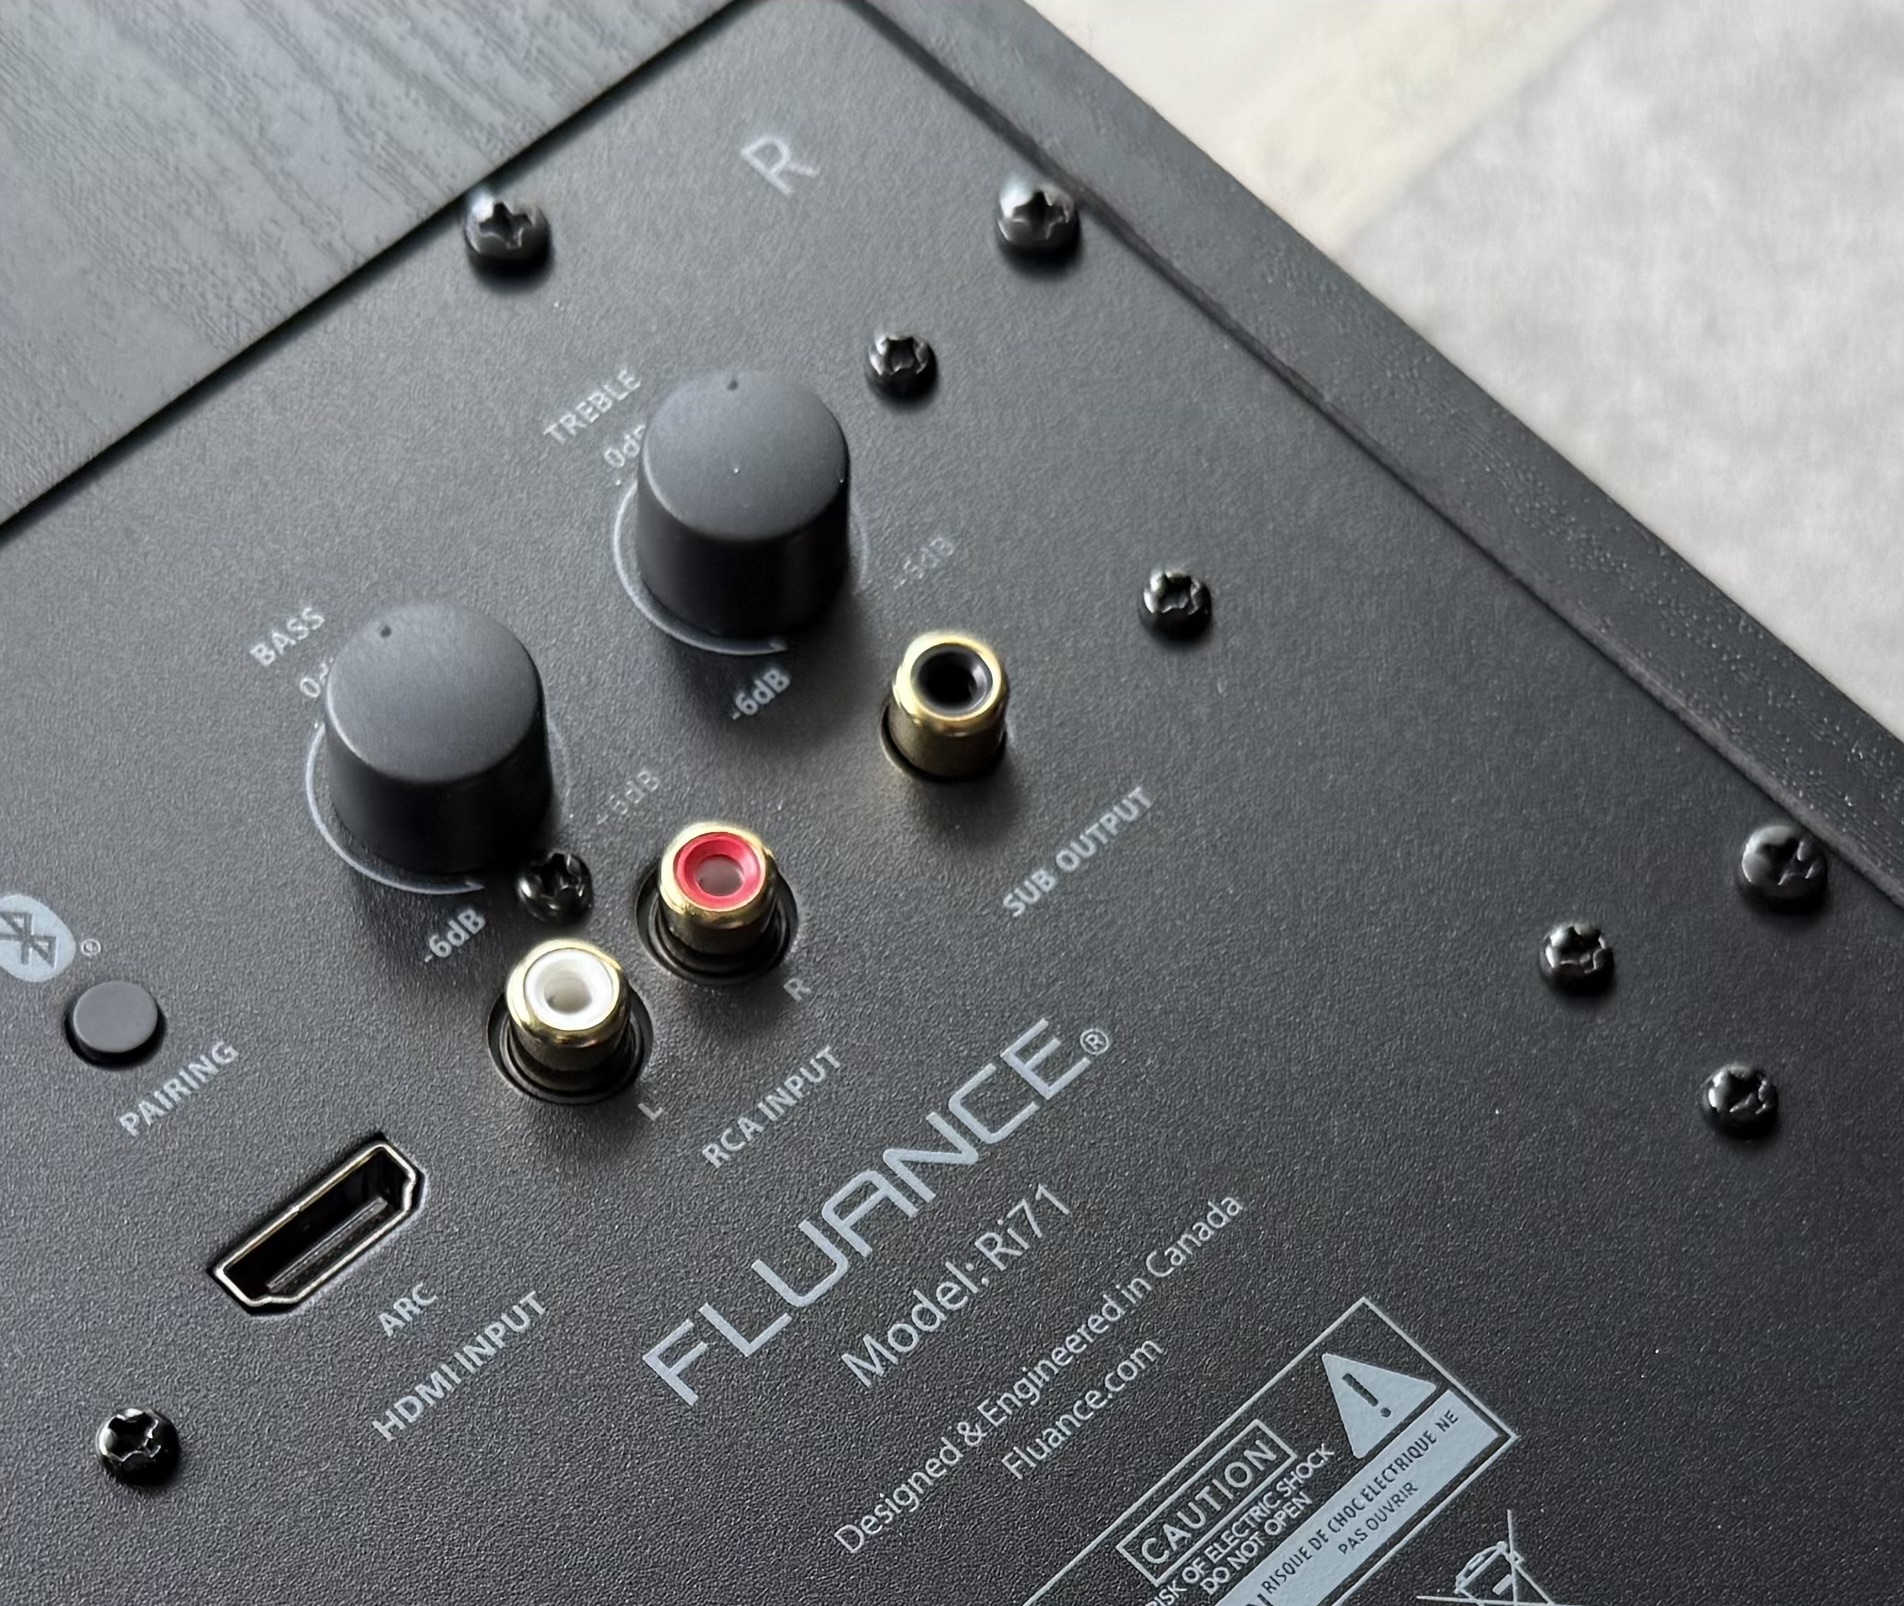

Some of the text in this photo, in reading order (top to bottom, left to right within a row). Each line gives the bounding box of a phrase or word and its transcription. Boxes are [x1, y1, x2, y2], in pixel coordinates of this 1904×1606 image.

[735, 128, 822, 198] R
[540, 367, 647, 449] TREBLE
[246, 604, 329, 668] BASS
[718, 663, 795, 726] -6dB
[1001, 785, 1152, 917] SUB OUTPUT
[411, 902, 492, 969] -6dB
[116, 1036, 244, 1139] PAIRING
[636, 1094, 668, 1123] L
[701, 1043, 841, 1169] RCA INPUT
[373, 1279, 441, 1338] ARC
[839, 1182, 1070, 1388] Model: Ri71
[370, 1289, 550, 1443] HDMI INPUT
[832, 1195, 1244, 1554] Designed & Engineered in Canada
[1000, 1339, 1164, 1480] Fluance.com
[1140, 1438, 1277, 1564] CAUTION
[1180, 1556, 1206, 1584] OF
[1203, 1490, 1282, 1564] ELECTRIC
[1275, 1441, 1335, 1497] SHOCK
[1199, 1490, 1313, 1595] DO NOT OPEN
[1260, 1408, 1459, 1594] RISQUE DE CHOC ELECTRIQUE NE
[1337, 1481, 1419, 1555] PAS OUVRIR
